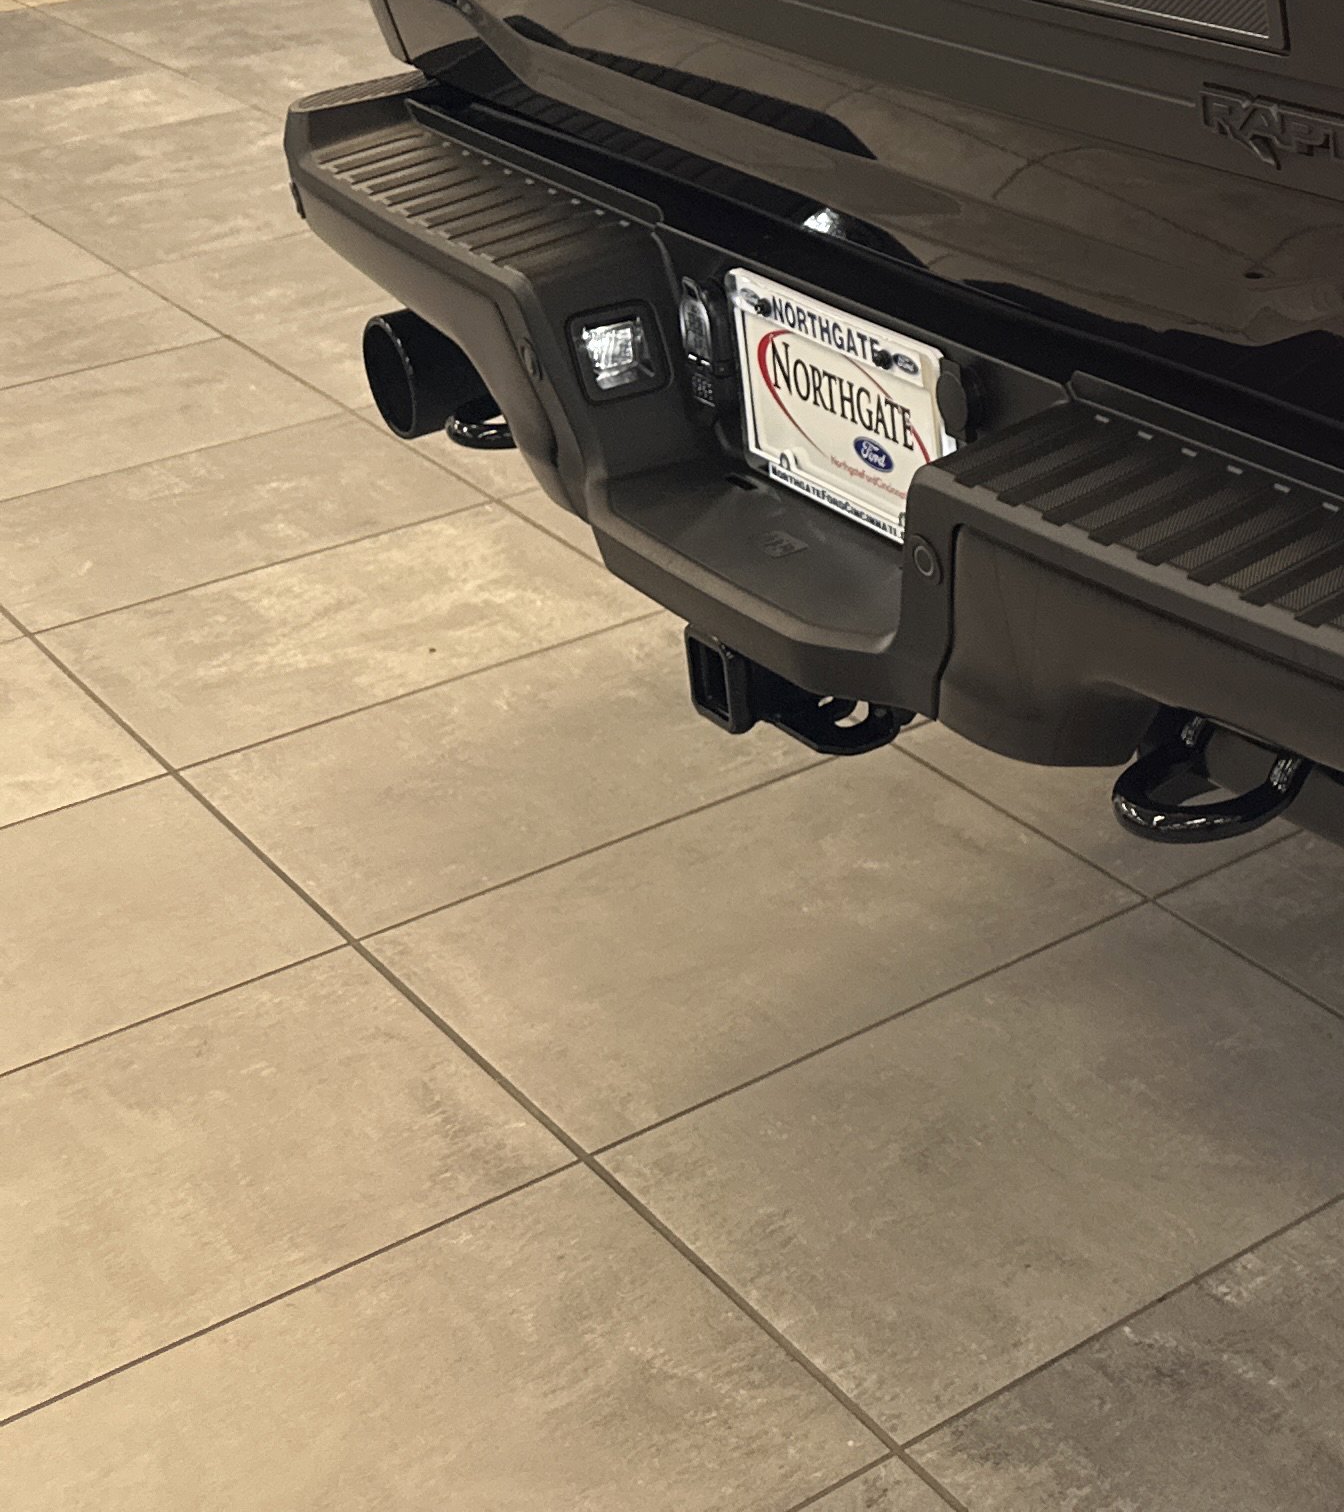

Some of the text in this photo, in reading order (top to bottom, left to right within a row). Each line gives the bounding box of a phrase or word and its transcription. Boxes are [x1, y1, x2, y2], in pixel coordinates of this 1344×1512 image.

[771, 295, 881, 363] NORTHGATE
[771, 338, 915, 451] NORTHGATE
[860, 440, 886, 468] Ford
